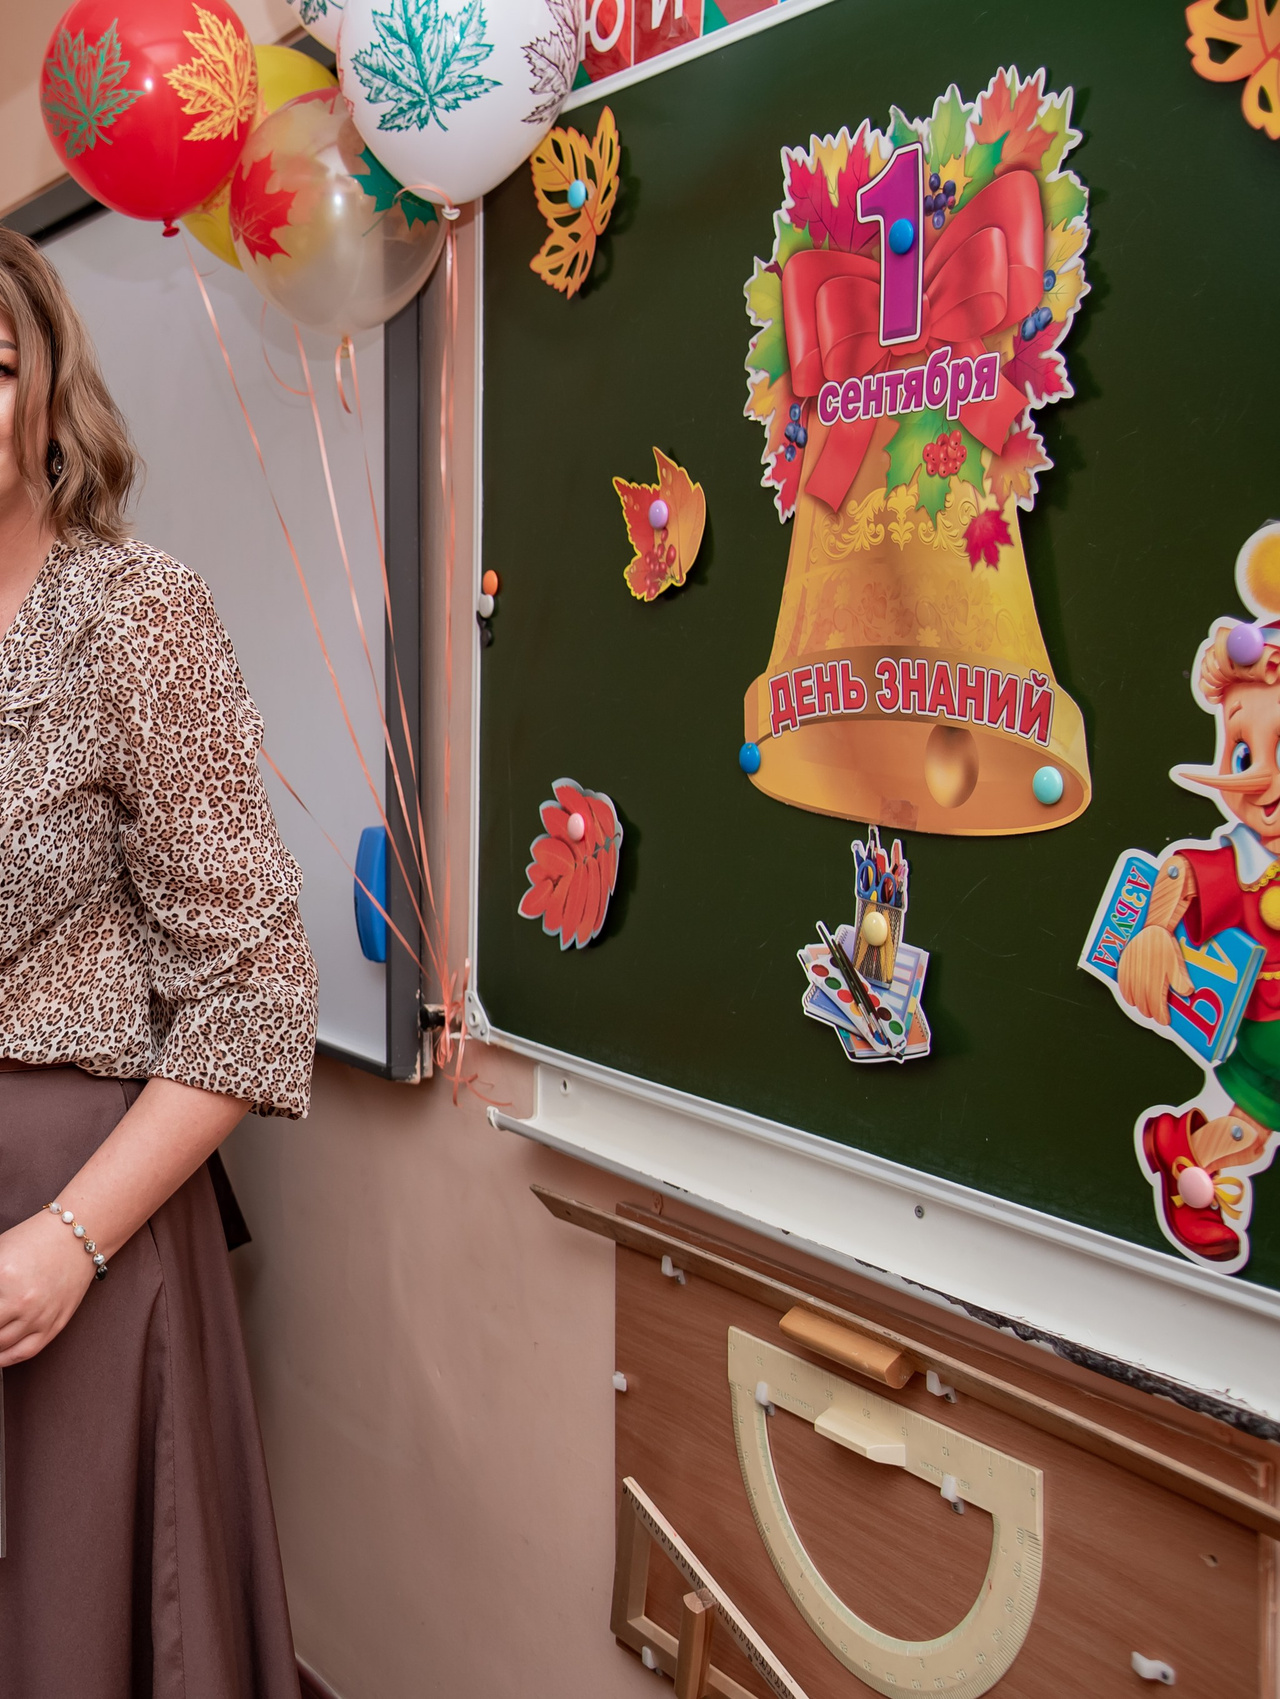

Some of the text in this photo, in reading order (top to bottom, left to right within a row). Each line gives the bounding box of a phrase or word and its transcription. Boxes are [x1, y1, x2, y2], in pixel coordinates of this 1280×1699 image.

[856, 142, 924, 346] 1
[817, 345, 1001, 426] сентября
[768, 657, 1055, 746] ДЕНЬ ЗНАНИЙ
[1092, 866, 1152, 969] АЗБУКА
